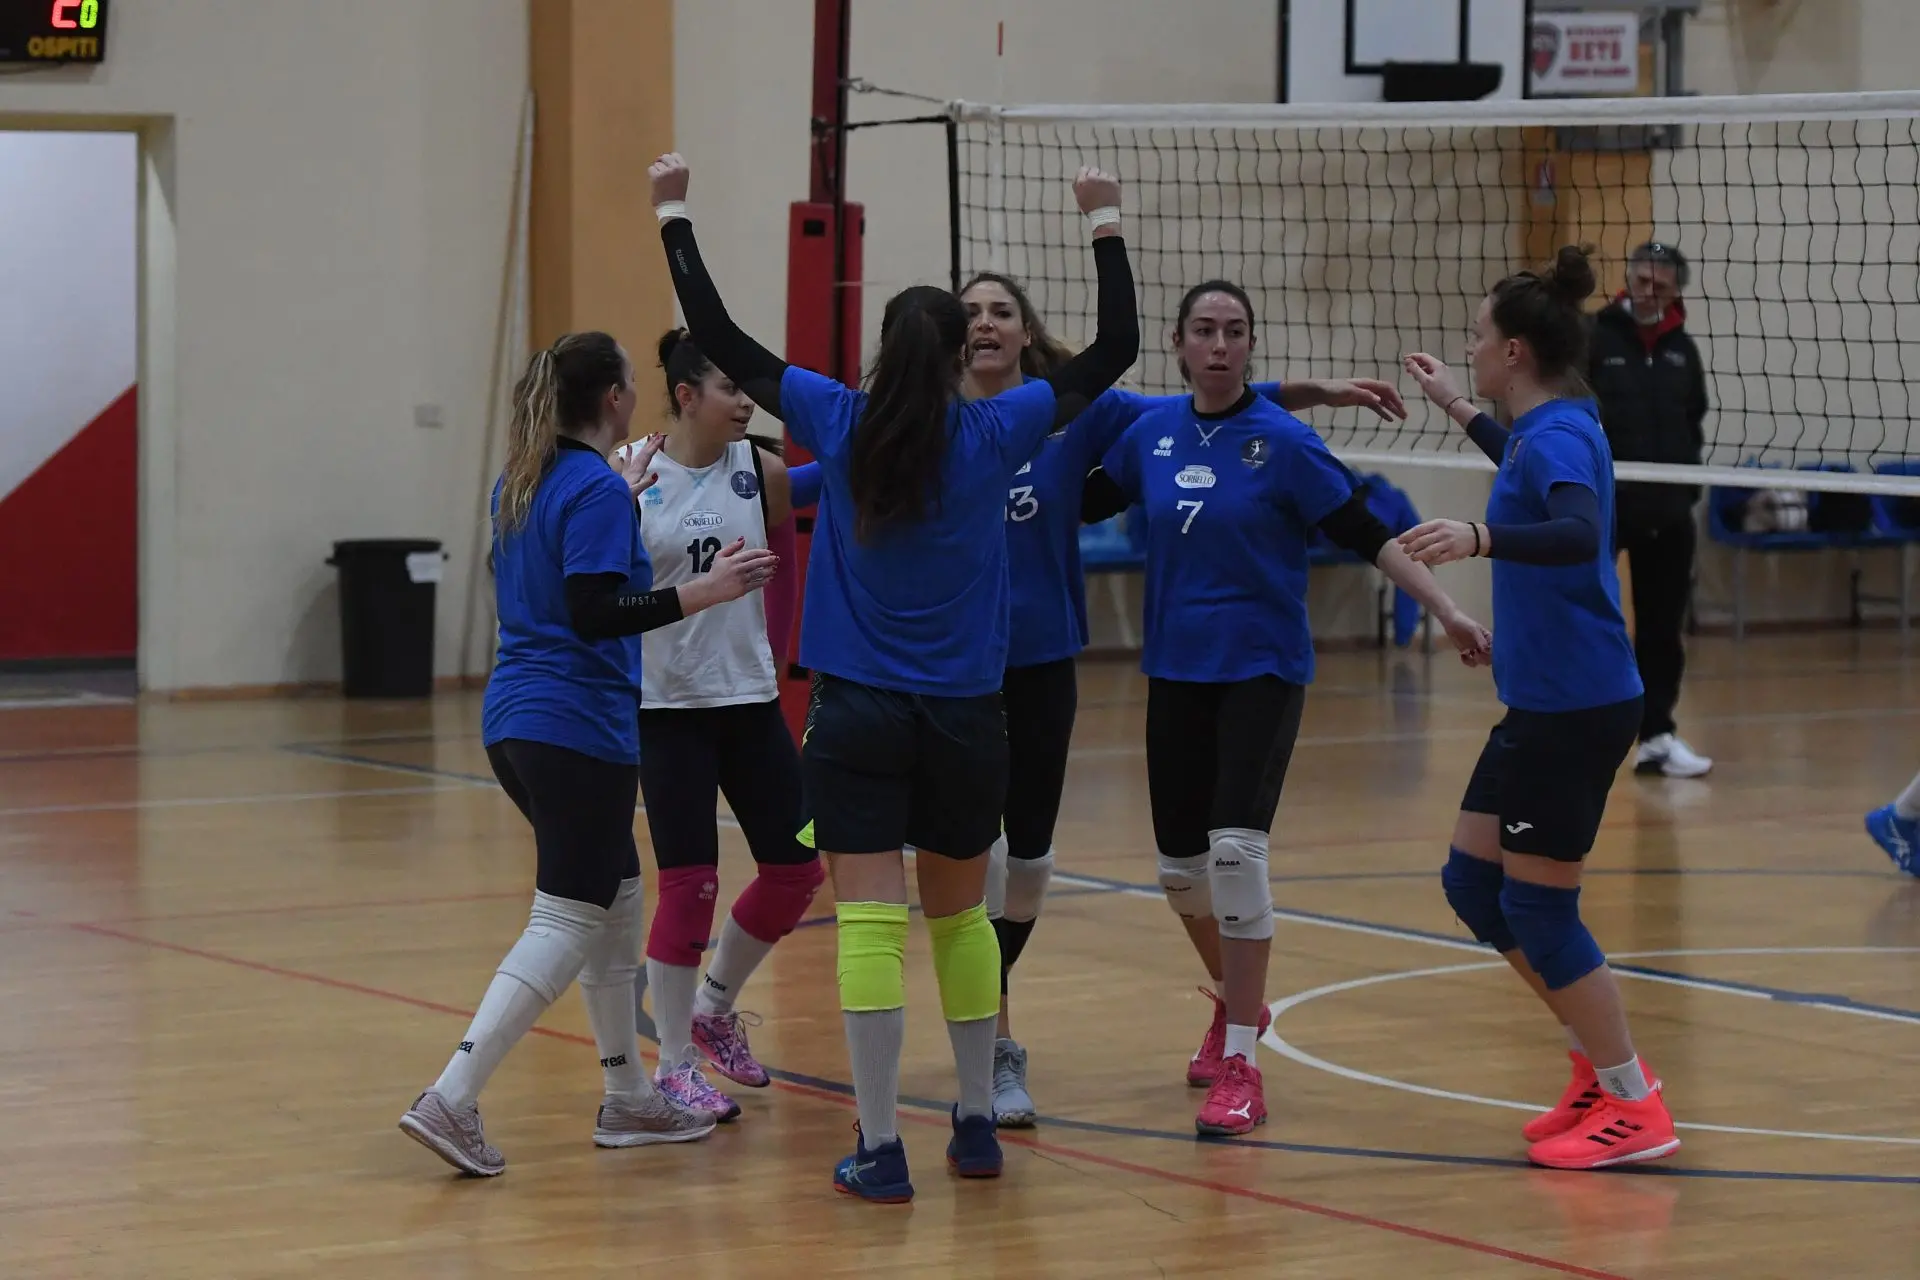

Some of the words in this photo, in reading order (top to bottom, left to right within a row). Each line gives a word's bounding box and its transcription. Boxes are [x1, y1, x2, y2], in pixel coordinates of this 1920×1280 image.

[28, 36, 98, 58] OSPITI
[1179, 473, 1214, 486] SORBELLO
[1004, 485, 1039, 522] 3
[683, 515, 723, 529] SORBELLO
[1176, 499, 1204, 534] 7
[686, 536, 722, 574] 12
[618, 596, 658, 607] KIPSTA
